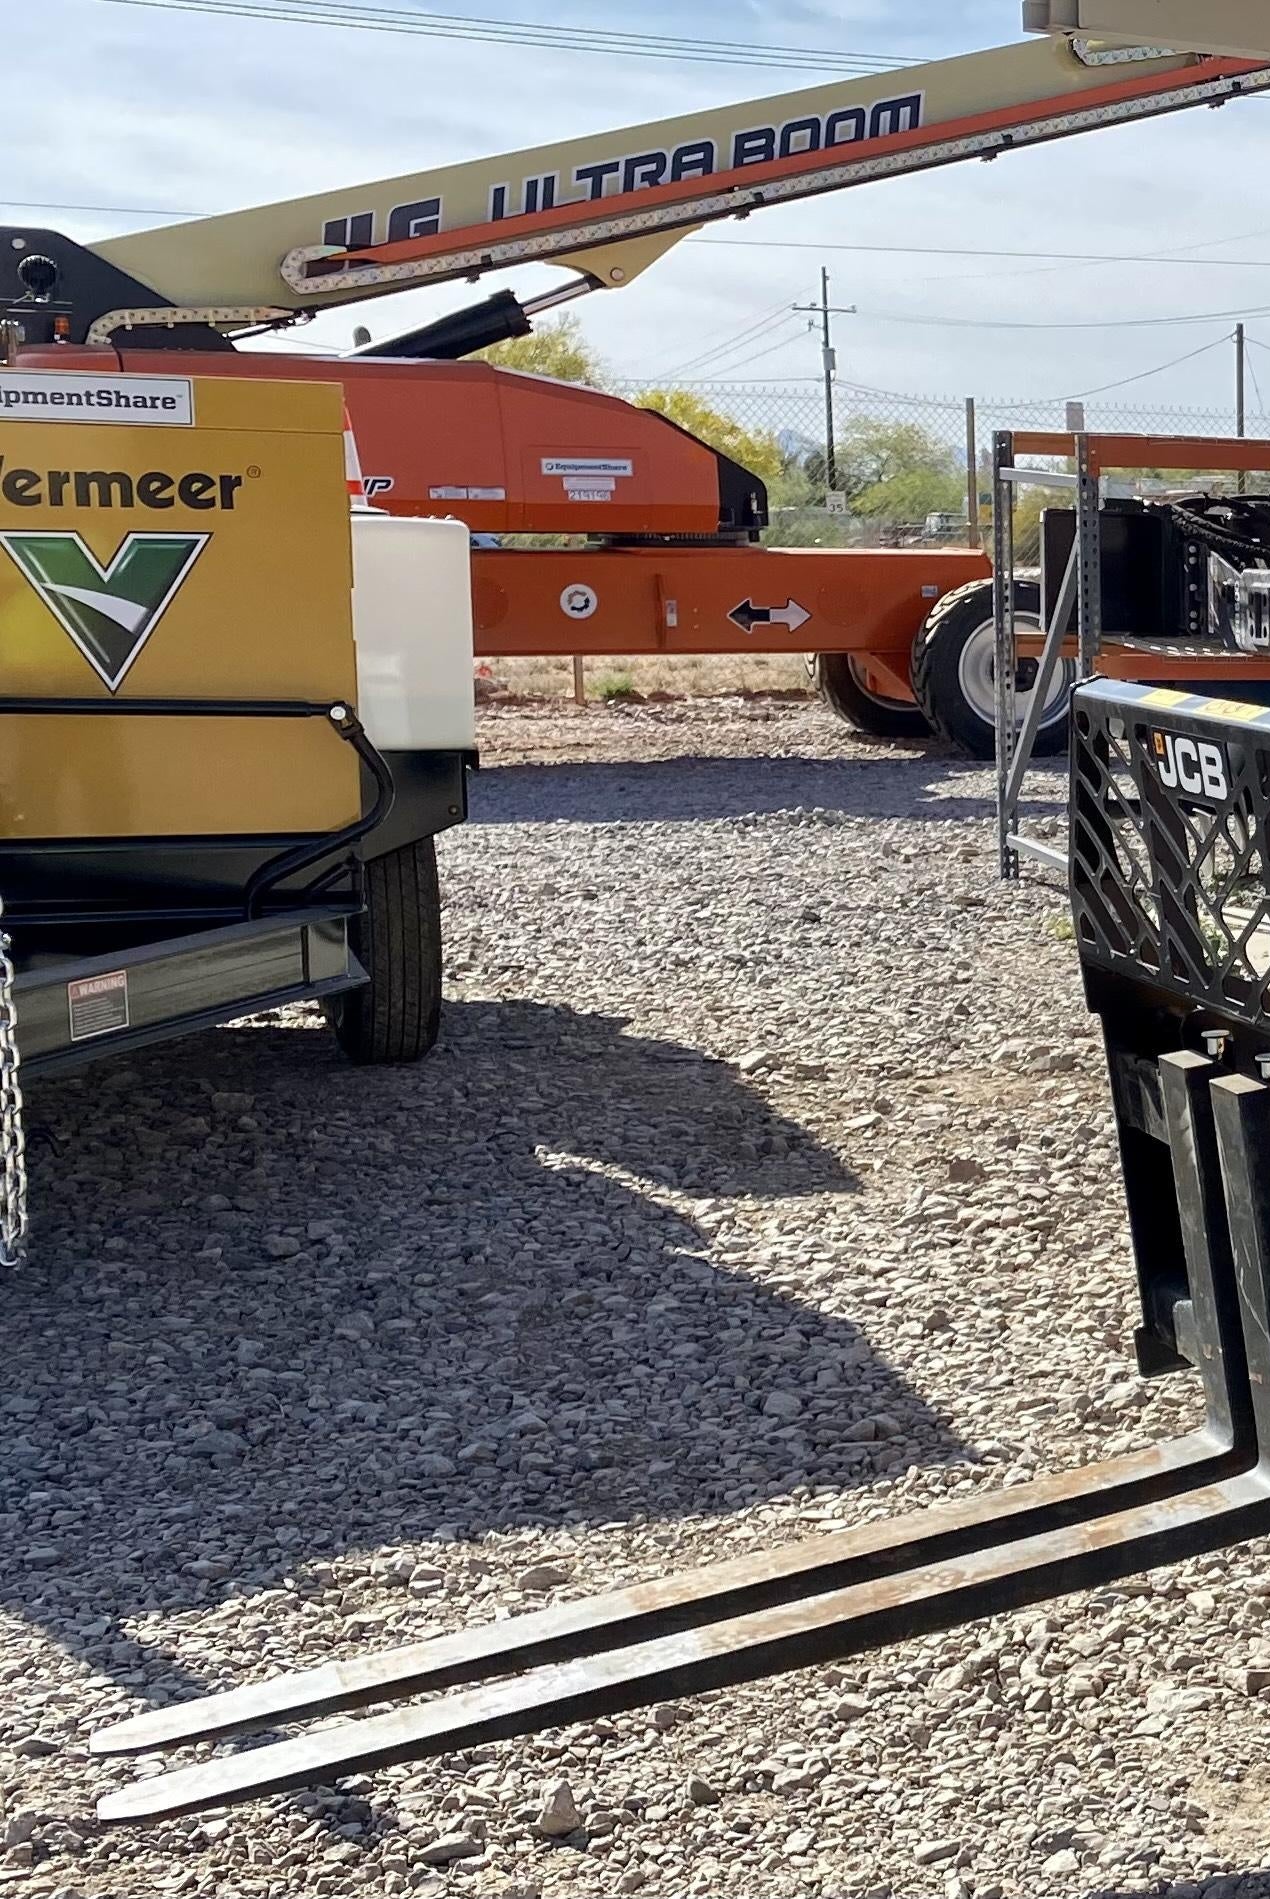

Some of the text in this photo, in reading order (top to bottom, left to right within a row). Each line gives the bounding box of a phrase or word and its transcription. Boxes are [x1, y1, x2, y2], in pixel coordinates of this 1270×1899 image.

[733, 94, 922, 168] BOOM
[0, 386, 176, 409] pmentShare
[0, 456, 242, 510] ermeer
[829, 503, 844, 512] 35
[1158, 734, 1228, 800] JCB
[78, 974, 125, 997] WARNING
